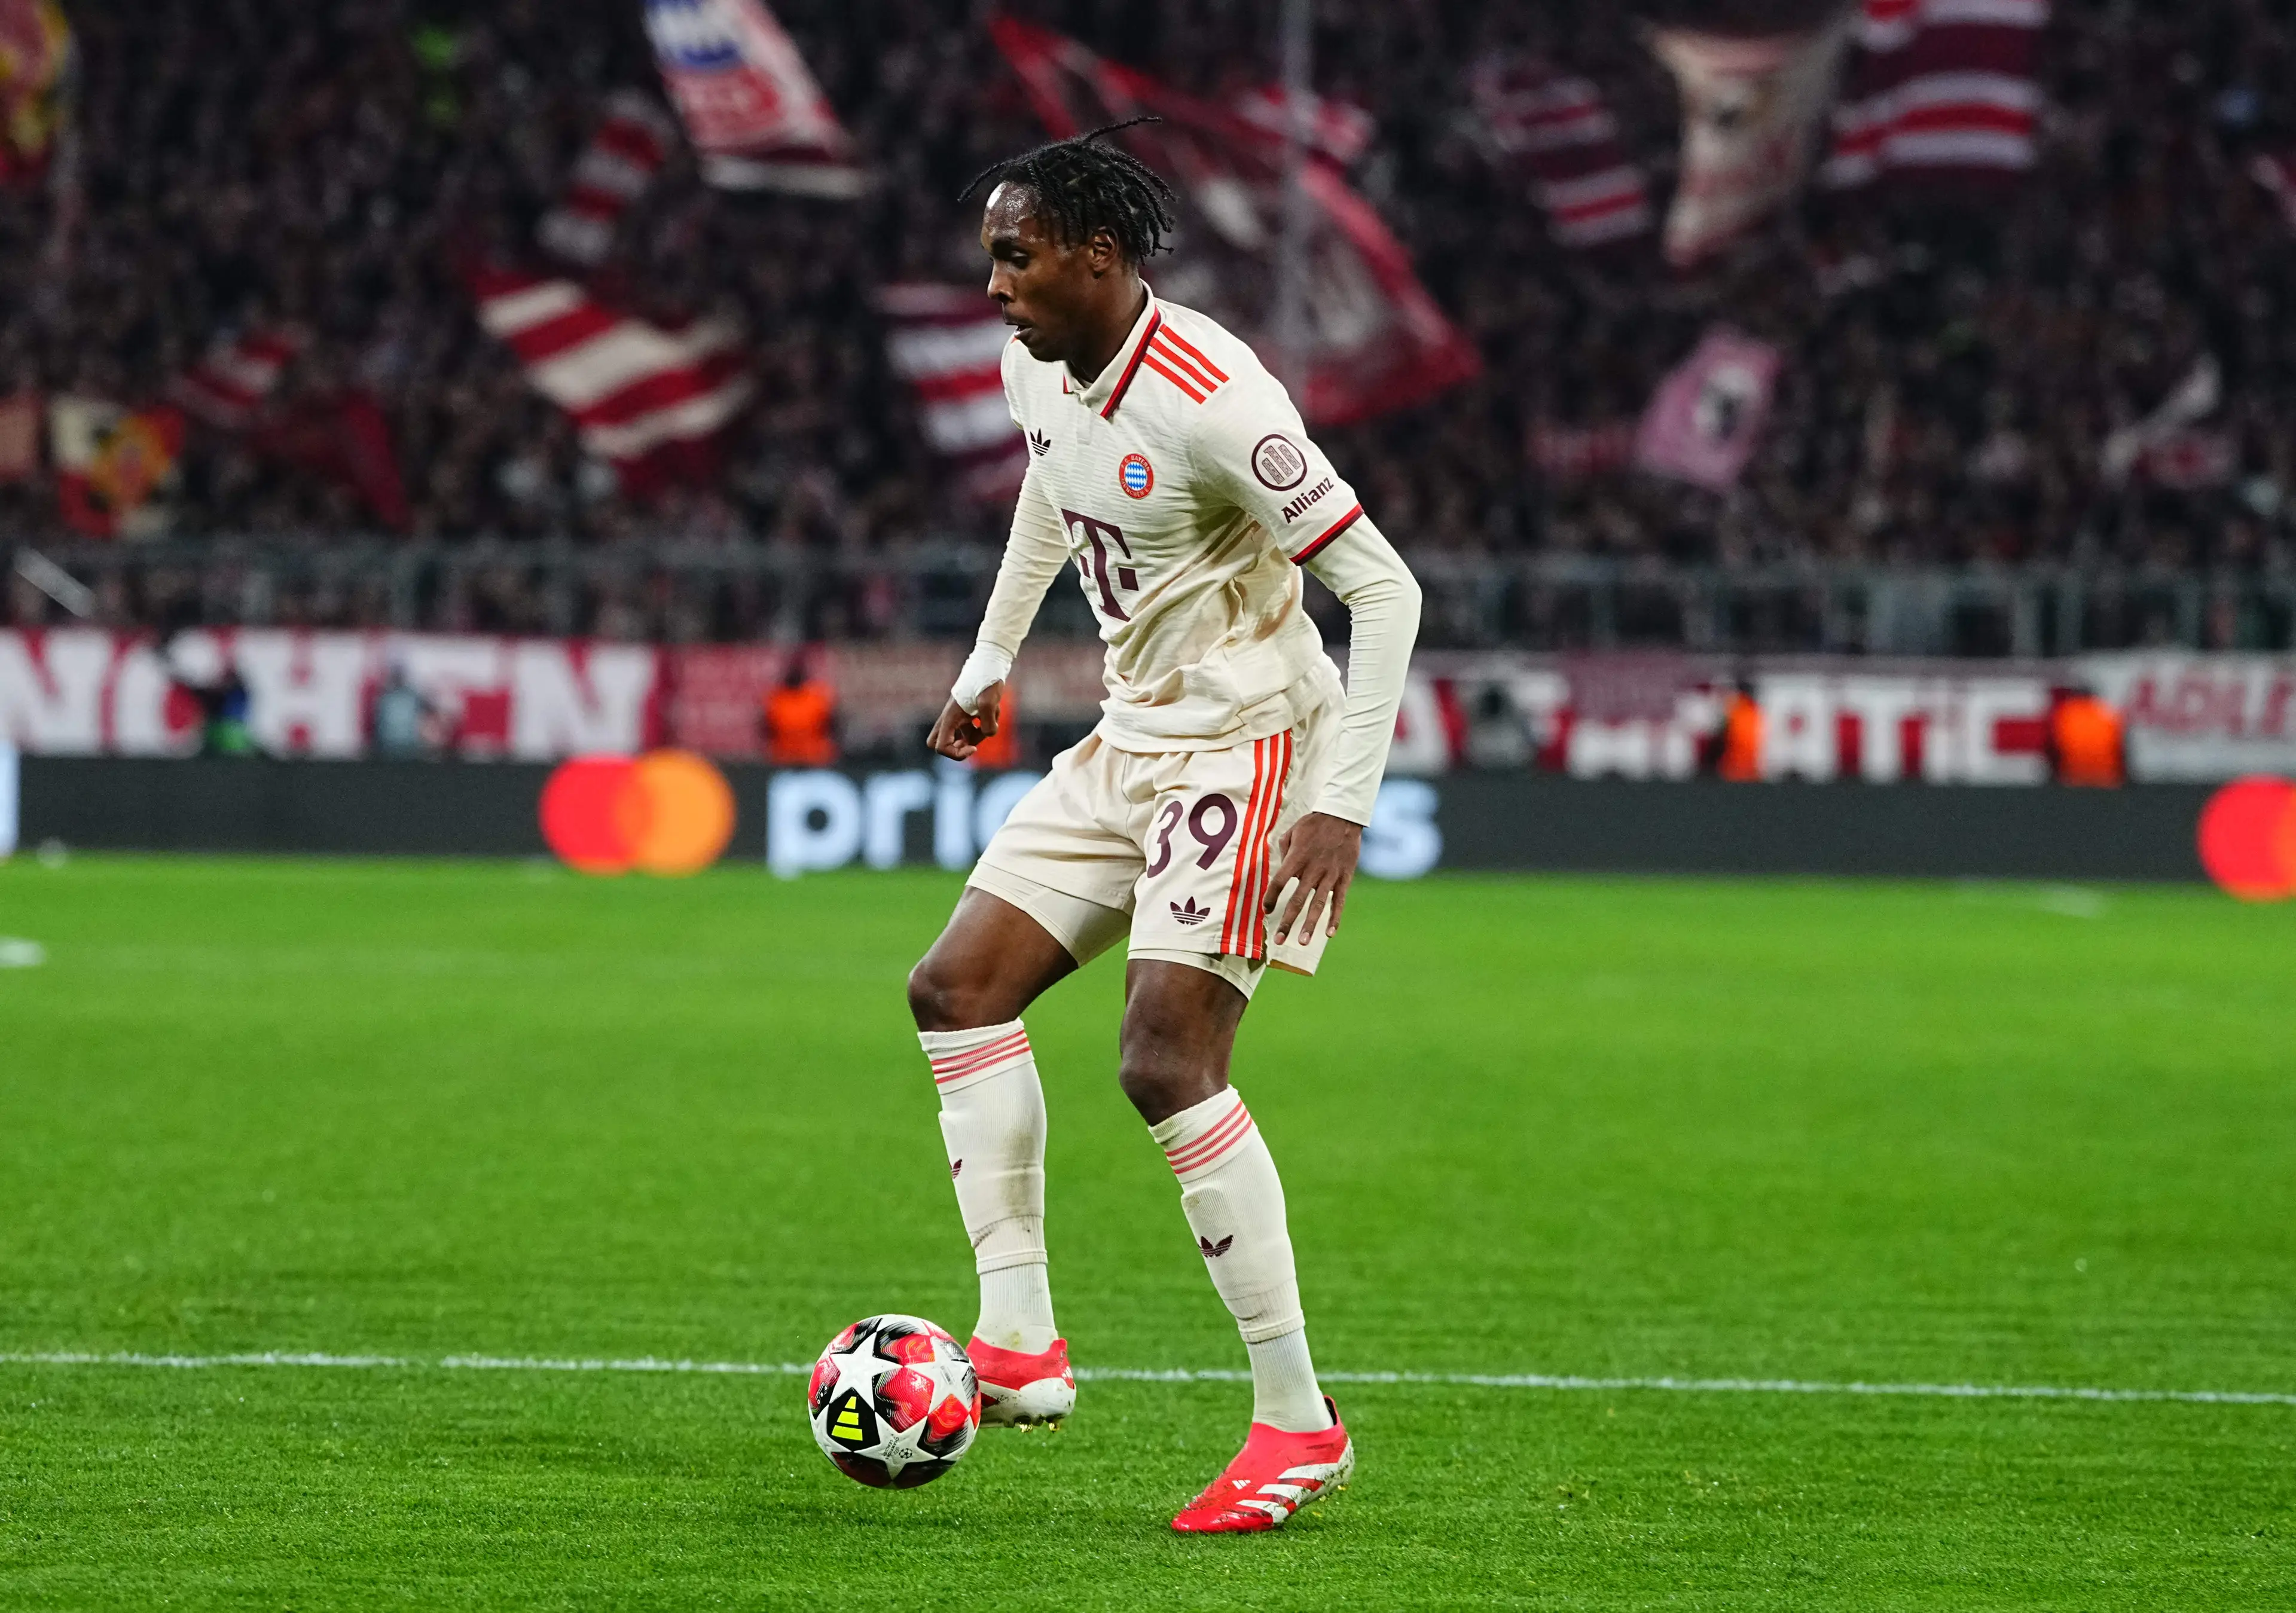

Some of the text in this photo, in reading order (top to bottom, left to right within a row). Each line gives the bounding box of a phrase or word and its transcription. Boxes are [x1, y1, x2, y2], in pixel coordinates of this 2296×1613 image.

[1131, 455, 1150, 472] BAYERN
[1281, 477, 1335, 524] Allianz
[1147, 793, 1238, 879] 39
